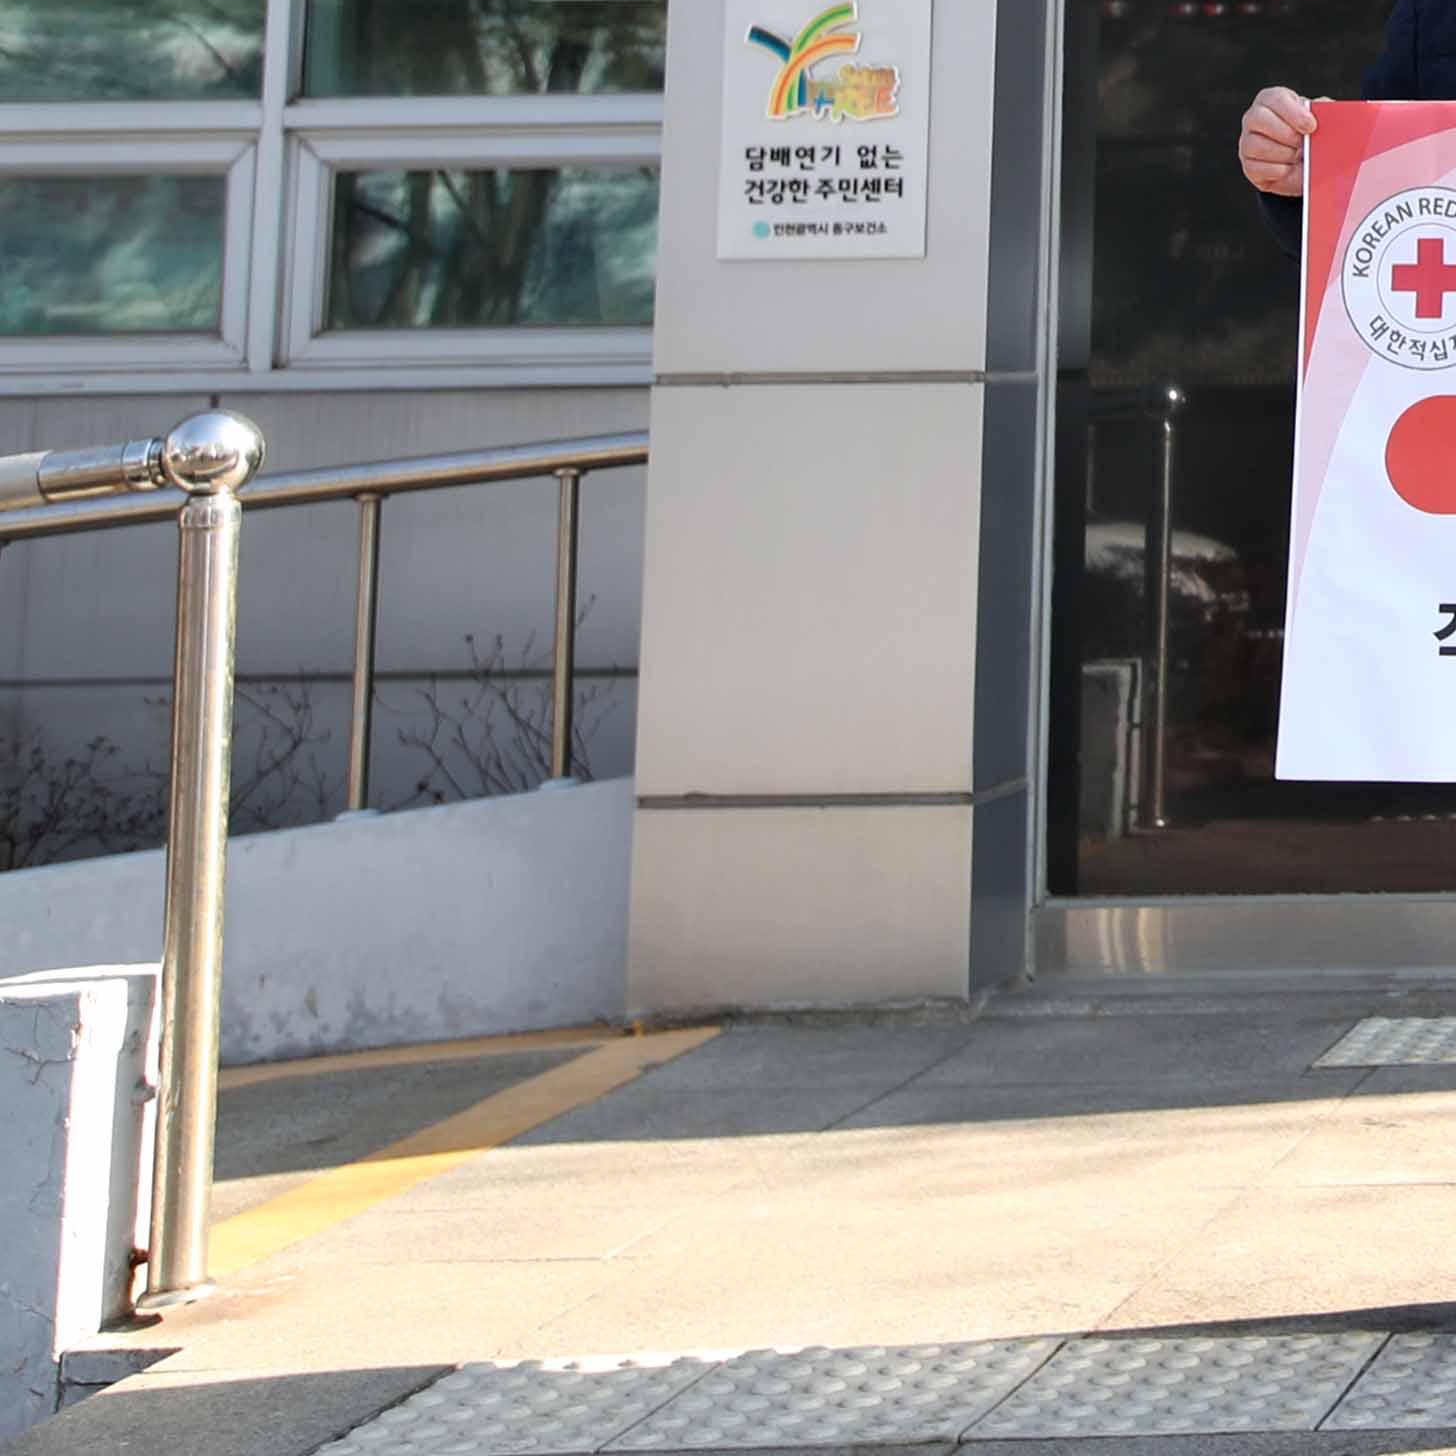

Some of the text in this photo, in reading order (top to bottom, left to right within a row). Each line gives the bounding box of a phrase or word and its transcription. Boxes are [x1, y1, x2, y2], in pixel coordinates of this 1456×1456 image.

[745, 145, 904, 171] 담배연기 없는
[744, 177, 903, 205] 건강한 주민센터
[1352, 201, 1413, 278] KOREAN
